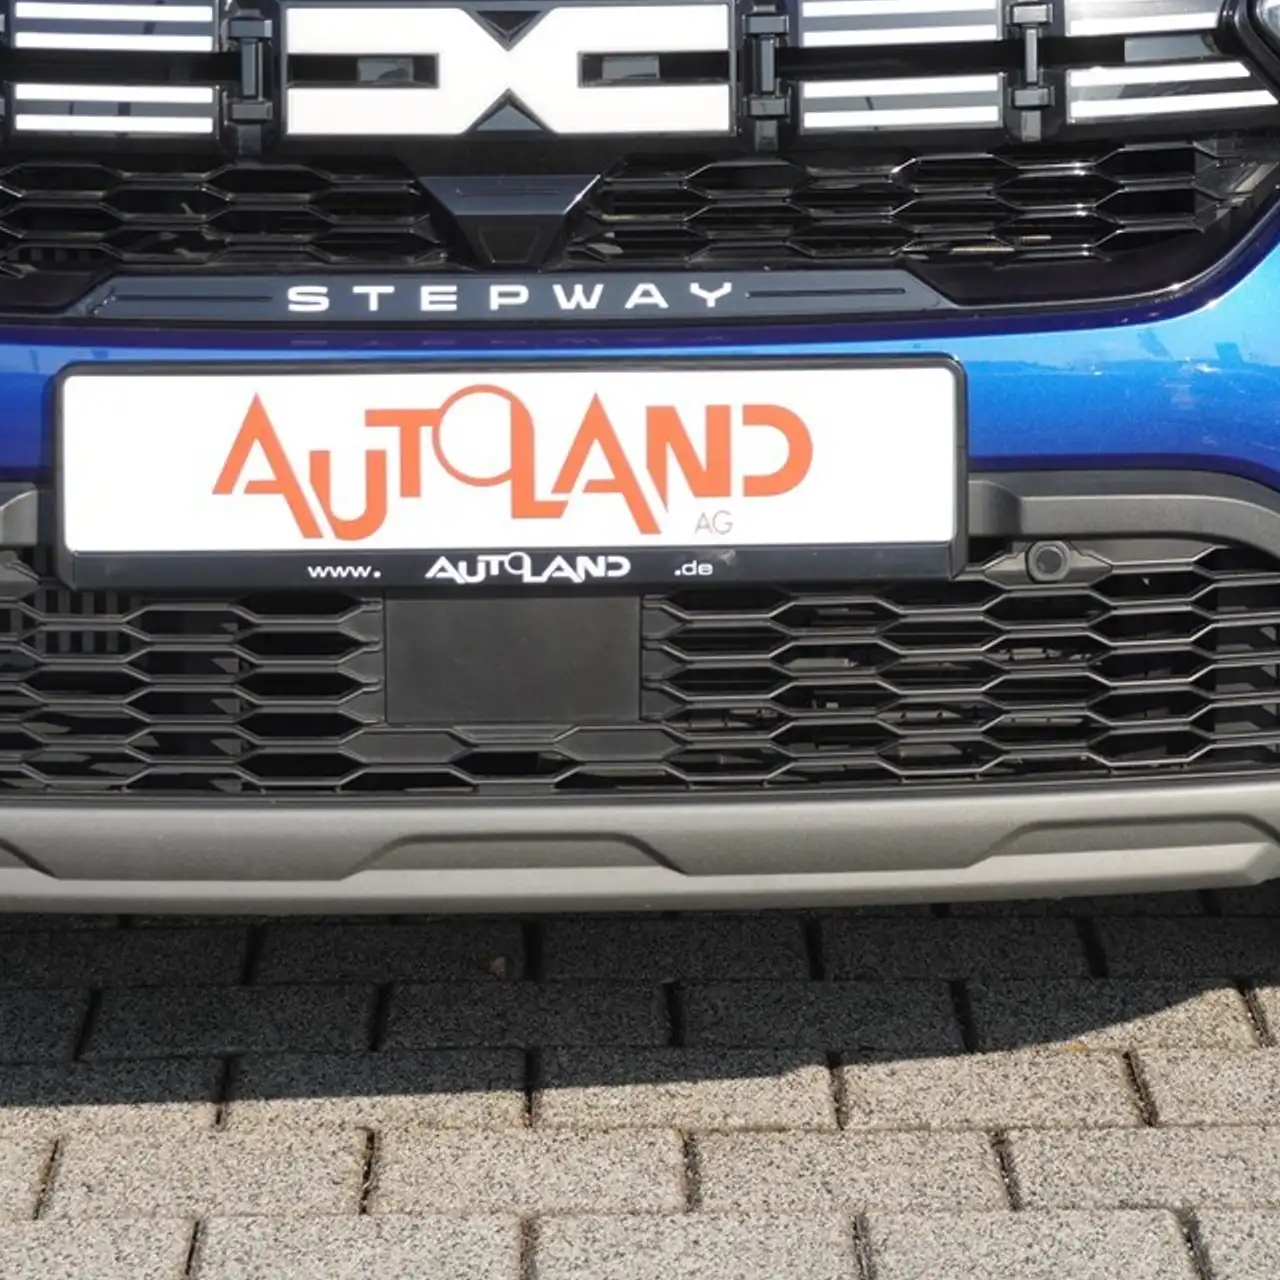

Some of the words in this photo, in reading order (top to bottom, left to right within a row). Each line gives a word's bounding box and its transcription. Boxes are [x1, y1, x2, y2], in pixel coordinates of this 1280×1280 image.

[287, 282, 733, 312] STEPWAY
[211, 384, 814, 541] AUTOLAND
[694, 510, 734, 536] AG
[307, 563, 382, 579] www.
[424, 552, 631, 584] AUTOLAND
[674, 560, 714, 577] .de
